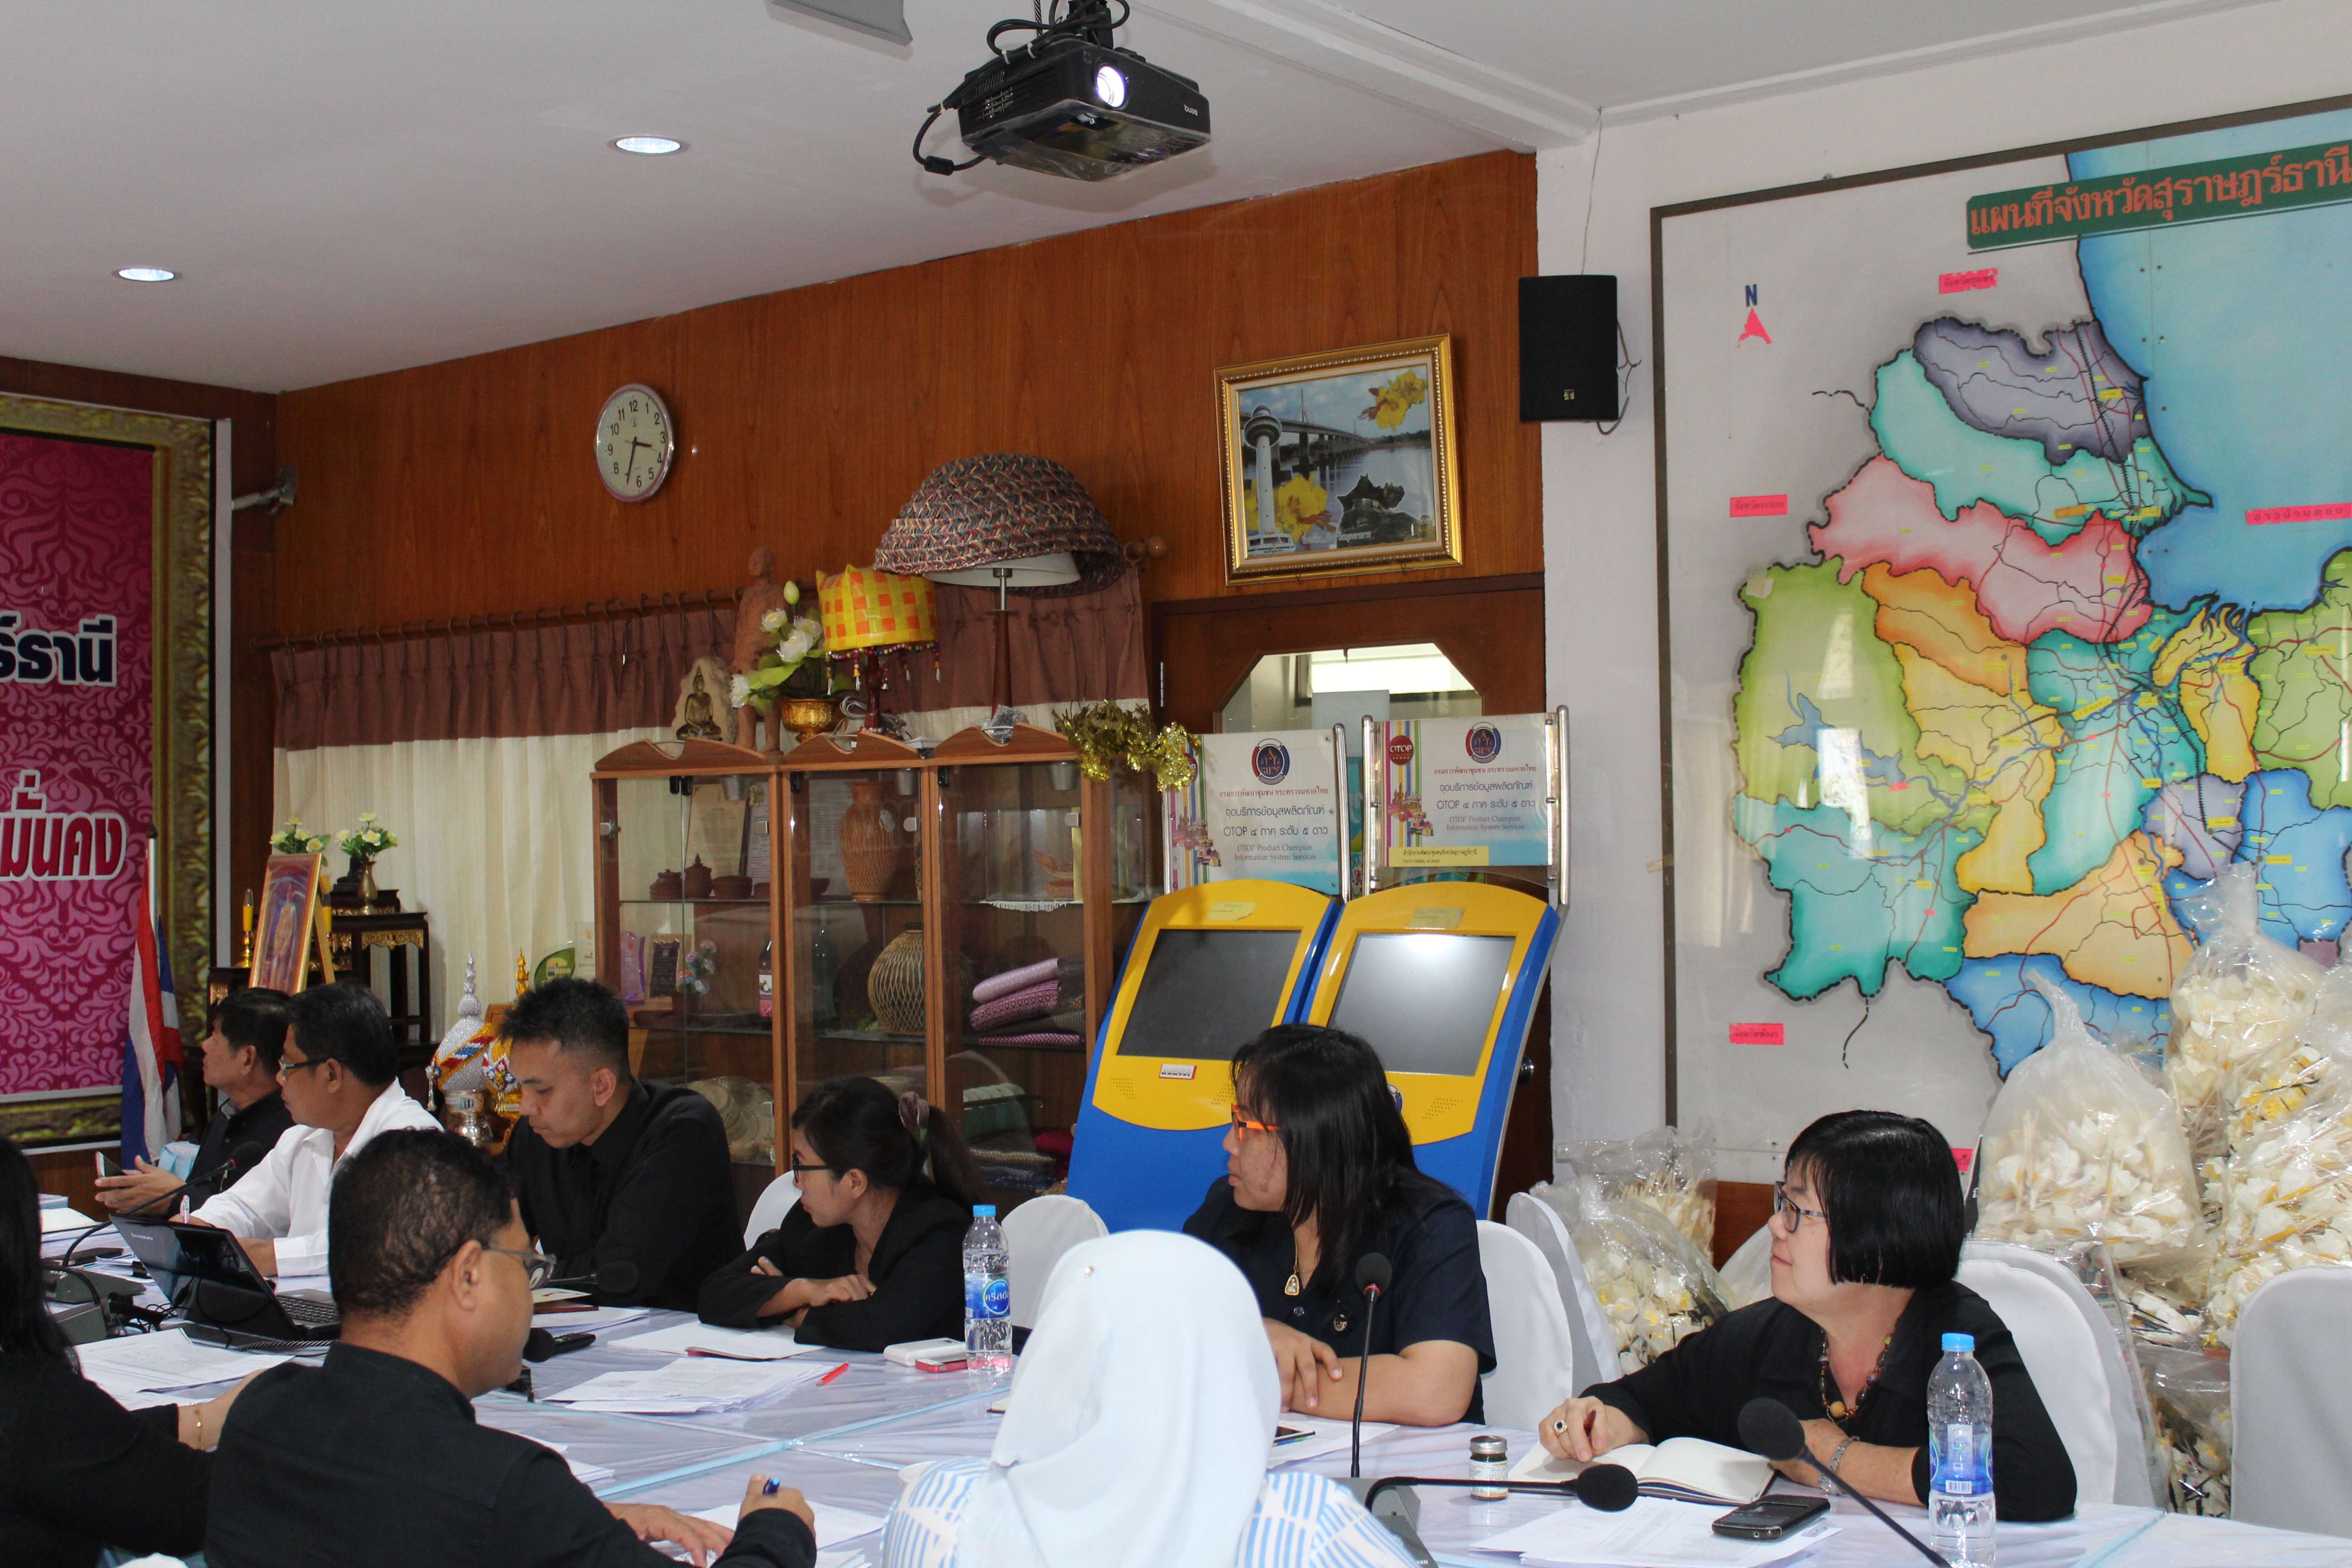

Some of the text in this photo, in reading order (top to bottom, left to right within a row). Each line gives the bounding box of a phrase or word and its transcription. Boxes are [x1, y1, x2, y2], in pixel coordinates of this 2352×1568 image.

[1970, 145, 2352, 235] แผนที่จังหวัดสุราษฎร์ธานี
[1745, 284, 1757, 307] N
[629, 400, 638, 412] 12
[645, 403, 649, 414] 1
[618, 409, 625, 420] 11
[654, 413, 660, 425] 2
[610, 423, 619, 436] 10
[660, 432, 665, 443] 3
[608, 444, 613, 456] 9
[657, 452, 662, 464] 4
[614, 463, 619, 474] 8
[648, 468, 654, 480] 5
[637, 475, 642, 488] 6
[1440, 780, 1533, 794] จุดบริการข้อมูลผลิตภัณฑ์
[1436, 800, 1460, 809] OTOP
[1490, 799, 1508, 808] ระดับ
[1225, 805, 1324, 818] จุดบริการข้อมูลผลิตภัณฑ์
[1224, 827, 1247, 836] OTOP
[1260, 828, 1276, 836] ภาค
[1279, 826, 1298, 835] ระดับ
[1313, 827, 1328, 835] ดาว
[1282, 844, 1313, 853] Champion
[1270, 853, 1290, 862] System
